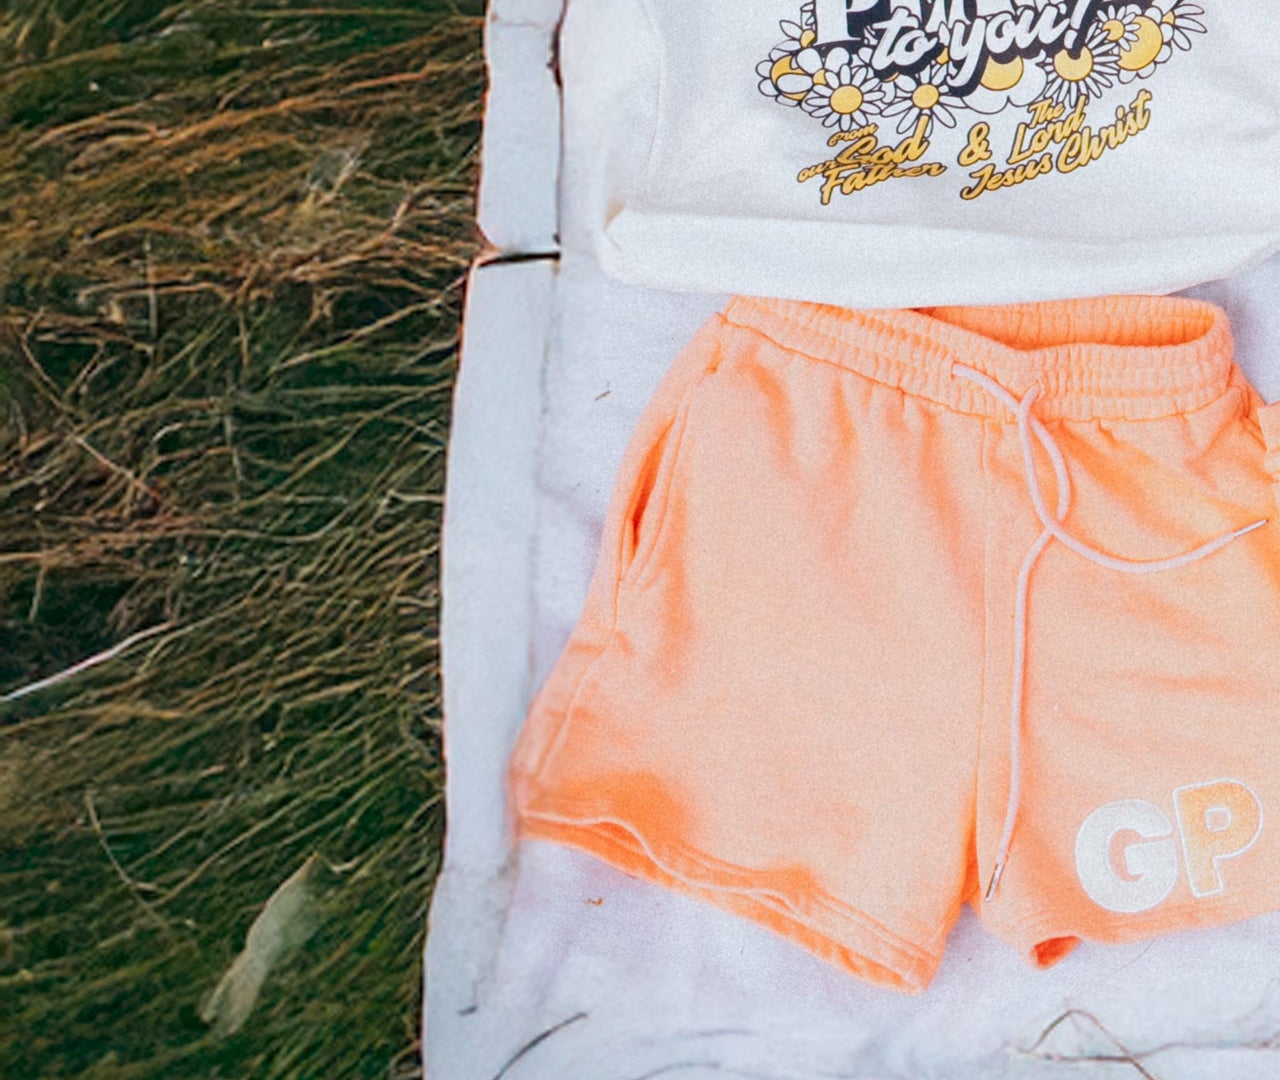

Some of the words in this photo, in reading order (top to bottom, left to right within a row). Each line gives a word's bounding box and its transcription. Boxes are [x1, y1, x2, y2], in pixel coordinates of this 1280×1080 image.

[868, 6, 938, 77] to
[827, 122, 879, 147] from
[1006, 94, 1088, 165] Lord
[1027, 96, 1066, 129] The
[835, 113, 931, 165] God
[957, 122, 993, 167] &
[960, 153, 1053, 200] Jesus
[1056, 88, 1153, 174] Christ
[797, 160, 838, 183] our
[820, 162, 948, 206] Father
[1074, 777, 1265, 914] GP
